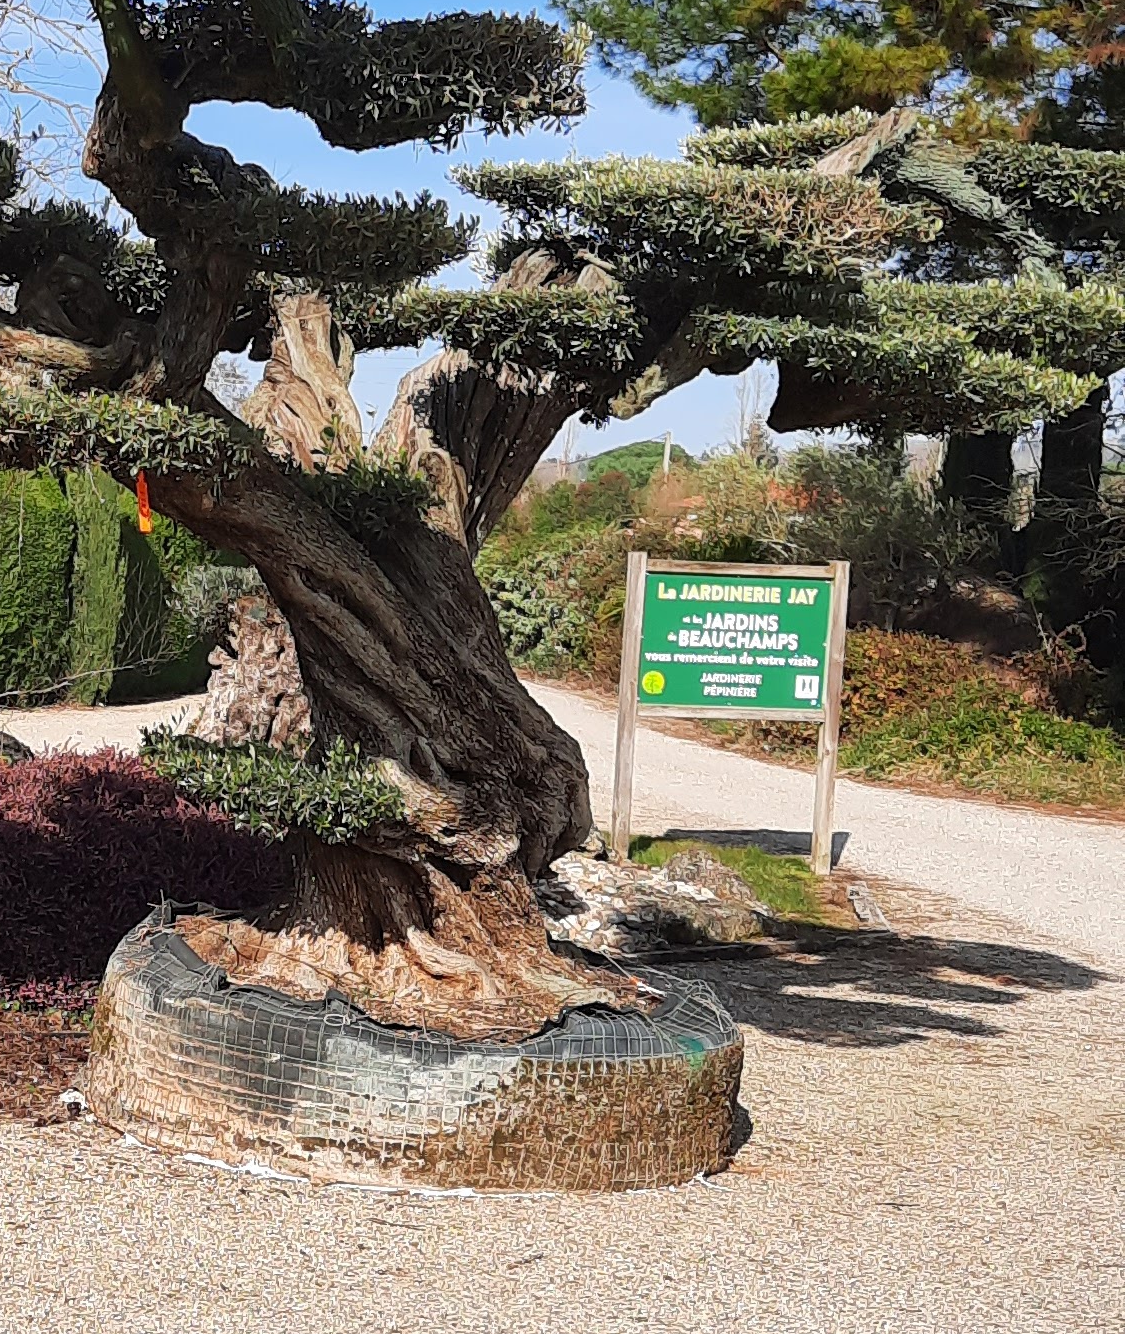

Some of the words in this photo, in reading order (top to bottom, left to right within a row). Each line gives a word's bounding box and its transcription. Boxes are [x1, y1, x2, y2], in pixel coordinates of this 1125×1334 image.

[658, 582, 677, 600] La
[679, 584, 781, 603] JARDINERIE
[787, 588, 818, 605] JAY
[703, 613, 778, 631] JARDINS
[678, 630, 798, 650] BEAUCHAMPS
[645, 653, 671, 662] vous
[673, 651, 737, 665] remercient
[739, 653, 754, 665] de
[756, 655, 786, 666] votre
[787, 654, 819, 667] visite
[700, 673, 762, 685] JARDINERIE
